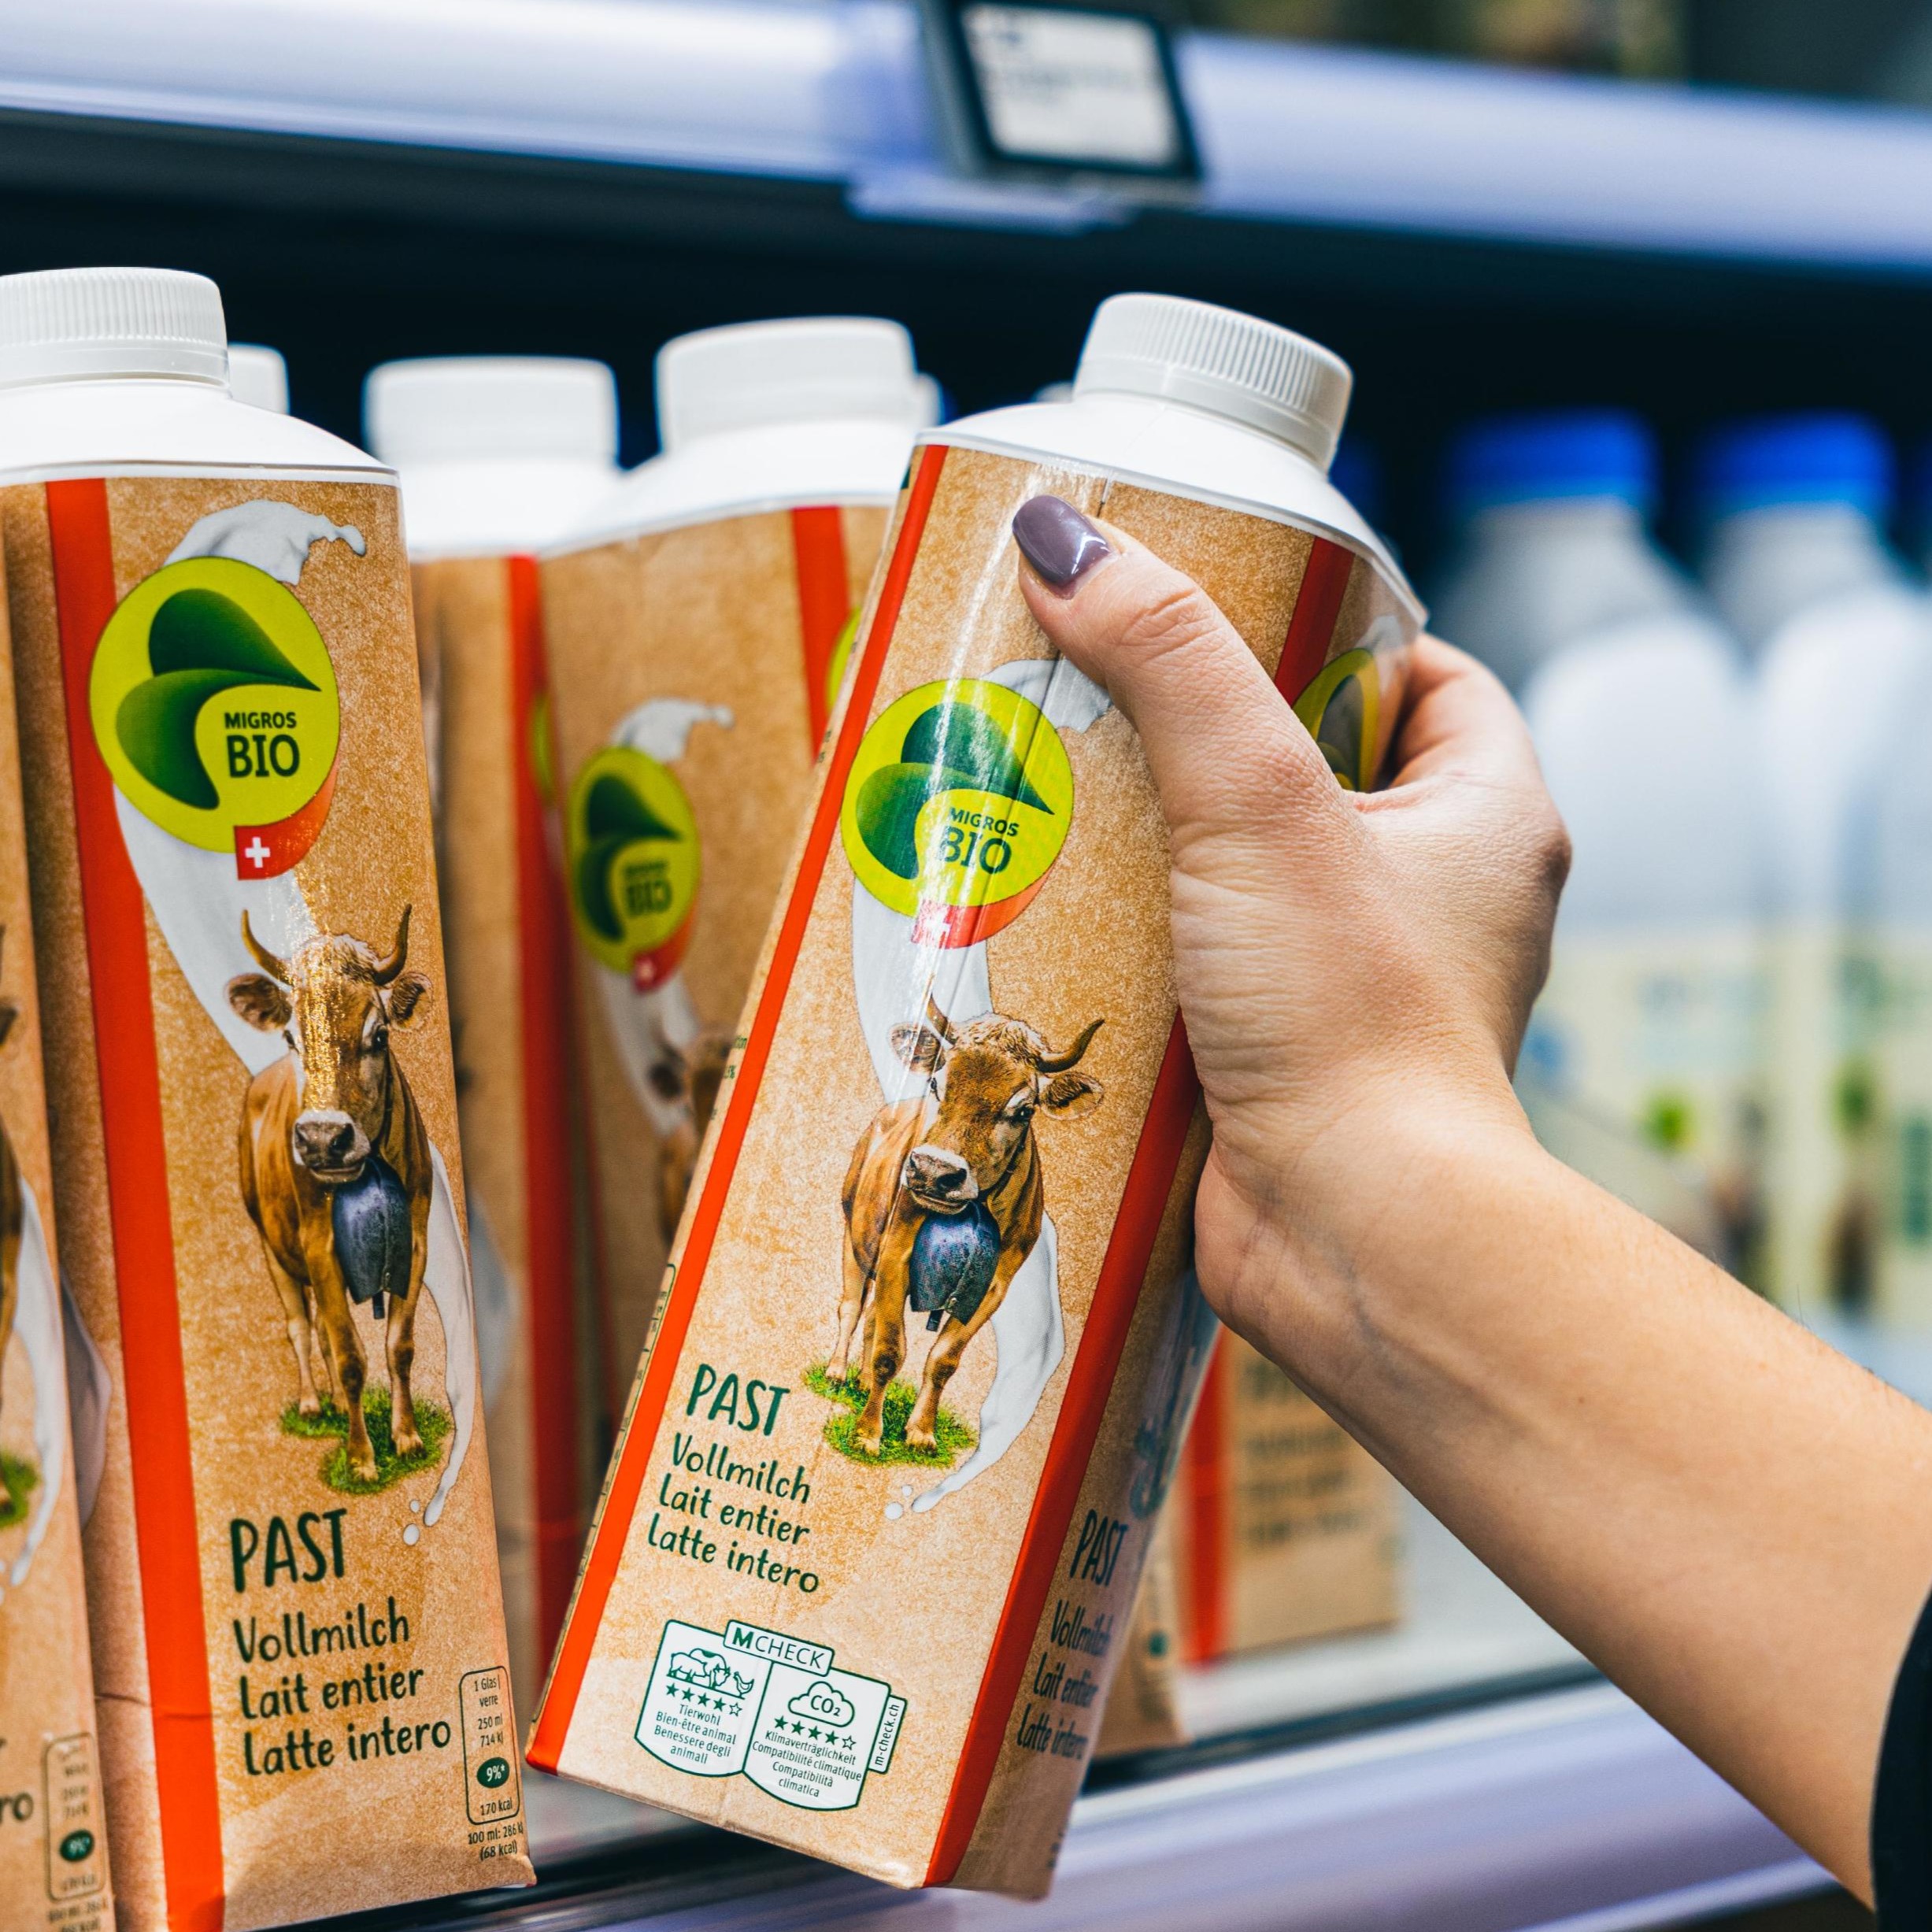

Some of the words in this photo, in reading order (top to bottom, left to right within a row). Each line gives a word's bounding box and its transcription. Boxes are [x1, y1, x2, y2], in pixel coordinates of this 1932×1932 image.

[224, 712, 296, 730] MIGROS
[227, 734, 300, 778] BIO
[950, 807, 1020, 836] MIGROS
[936, 826, 1012, 874] BIO
[687, 1364, 790, 1436] PAST
[673, 1433, 810, 1504] Vollmilch
[659, 1473, 710, 1519] Lait
[720, 1502, 810, 1545] entier
[230, 1508, 347, 1592] PAST
[647, 1512, 716, 1564] Latte
[727, 1541, 820, 1593] intero
[1070, 1508, 1128, 1586] PAST
[234, 1596, 409, 1663] Vollmilch
[239, 1674, 309, 1719] Lait
[324, 1663, 424, 1709] entier
[474, 1680, 479, 1692] 1
[481, 1677, 497, 1690] Glas
[1034, 1652, 1066, 1701] Lait
[479, 1695, 498, 1707] verre
[679, 1704, 720, 1726] Tierwohl
[478, 1716, 493, 1730] 250
[495, 1713, 503, 1726] ml
[656, 1711, 701, 1734] Bien-être
[702, 1727, 737, 1745] animal
[875, 1704, 899, 1766] m-check.ch
[1016, 1703, 1052, 1753] Latte
[244, 1728, 335, 1775] Latte
[347, 1716, 452, 1760] intero
[480, 1734, 495, 1747] 714
[654, 1725, 705, 1749] Benessere
[706, 1741, 731, 1757] degli
[670, 1745, 708, 1764] animali
[764, 1730, 857, 1765] Klimaverträglichkeit
[753, 1741, 812, 1767] Compatibilité
[813, 1759, 862, 1782] climatique
[772, 1761, 834, 1787] Compatibilità
[779, 1778, 820, 1797] climatica
[479, 1802, 496, 1816] 170
[498, 1797, 513, 1812] kcal
[468, 1831, 484, 1845] 100
[487, 1827, 501, 1840] ml:
[503, 1825, 516, 1838] 286
[479, 1845, 496, 1861] (68
[498, 1840, 517, 1856] kcal)
